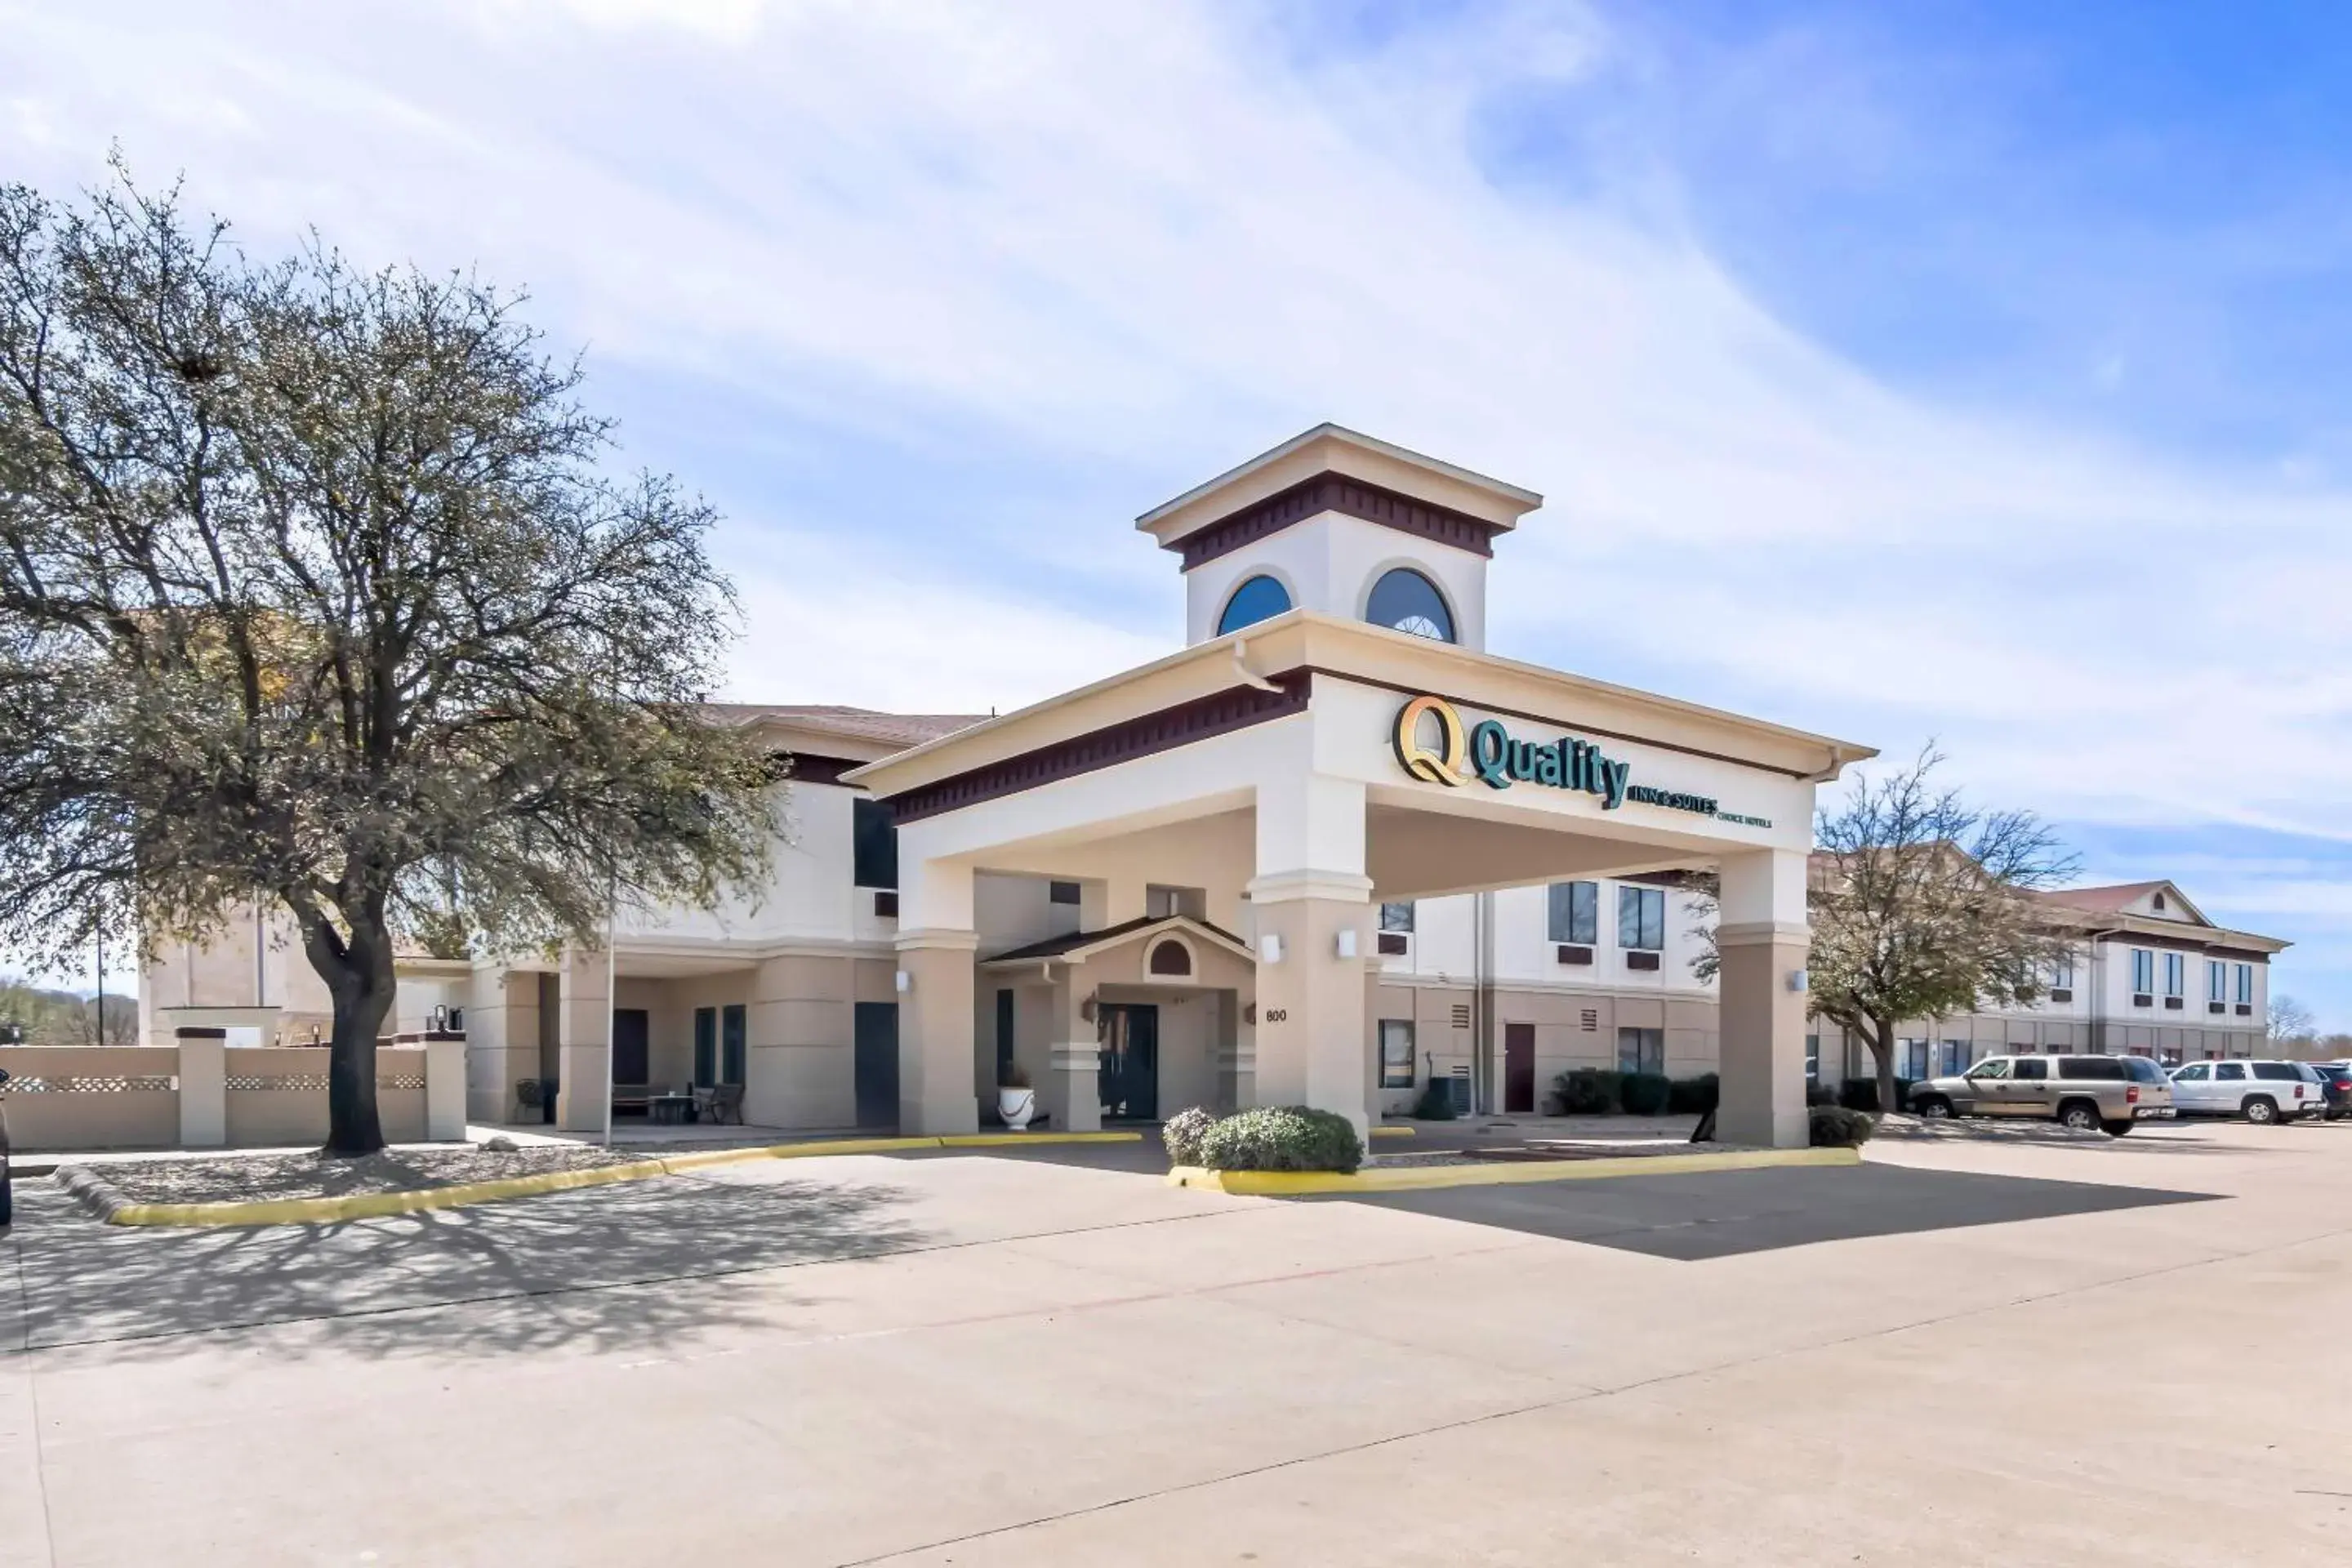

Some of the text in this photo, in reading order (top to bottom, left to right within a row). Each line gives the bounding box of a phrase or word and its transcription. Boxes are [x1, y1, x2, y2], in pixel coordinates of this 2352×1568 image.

[1392, 696, 1630, 810] Q Quality
[1628, 785, 1658, 803] INN
[1674, 793, 1718, 814] SUITES
[1266, 1009, 1287, 1022] 800
